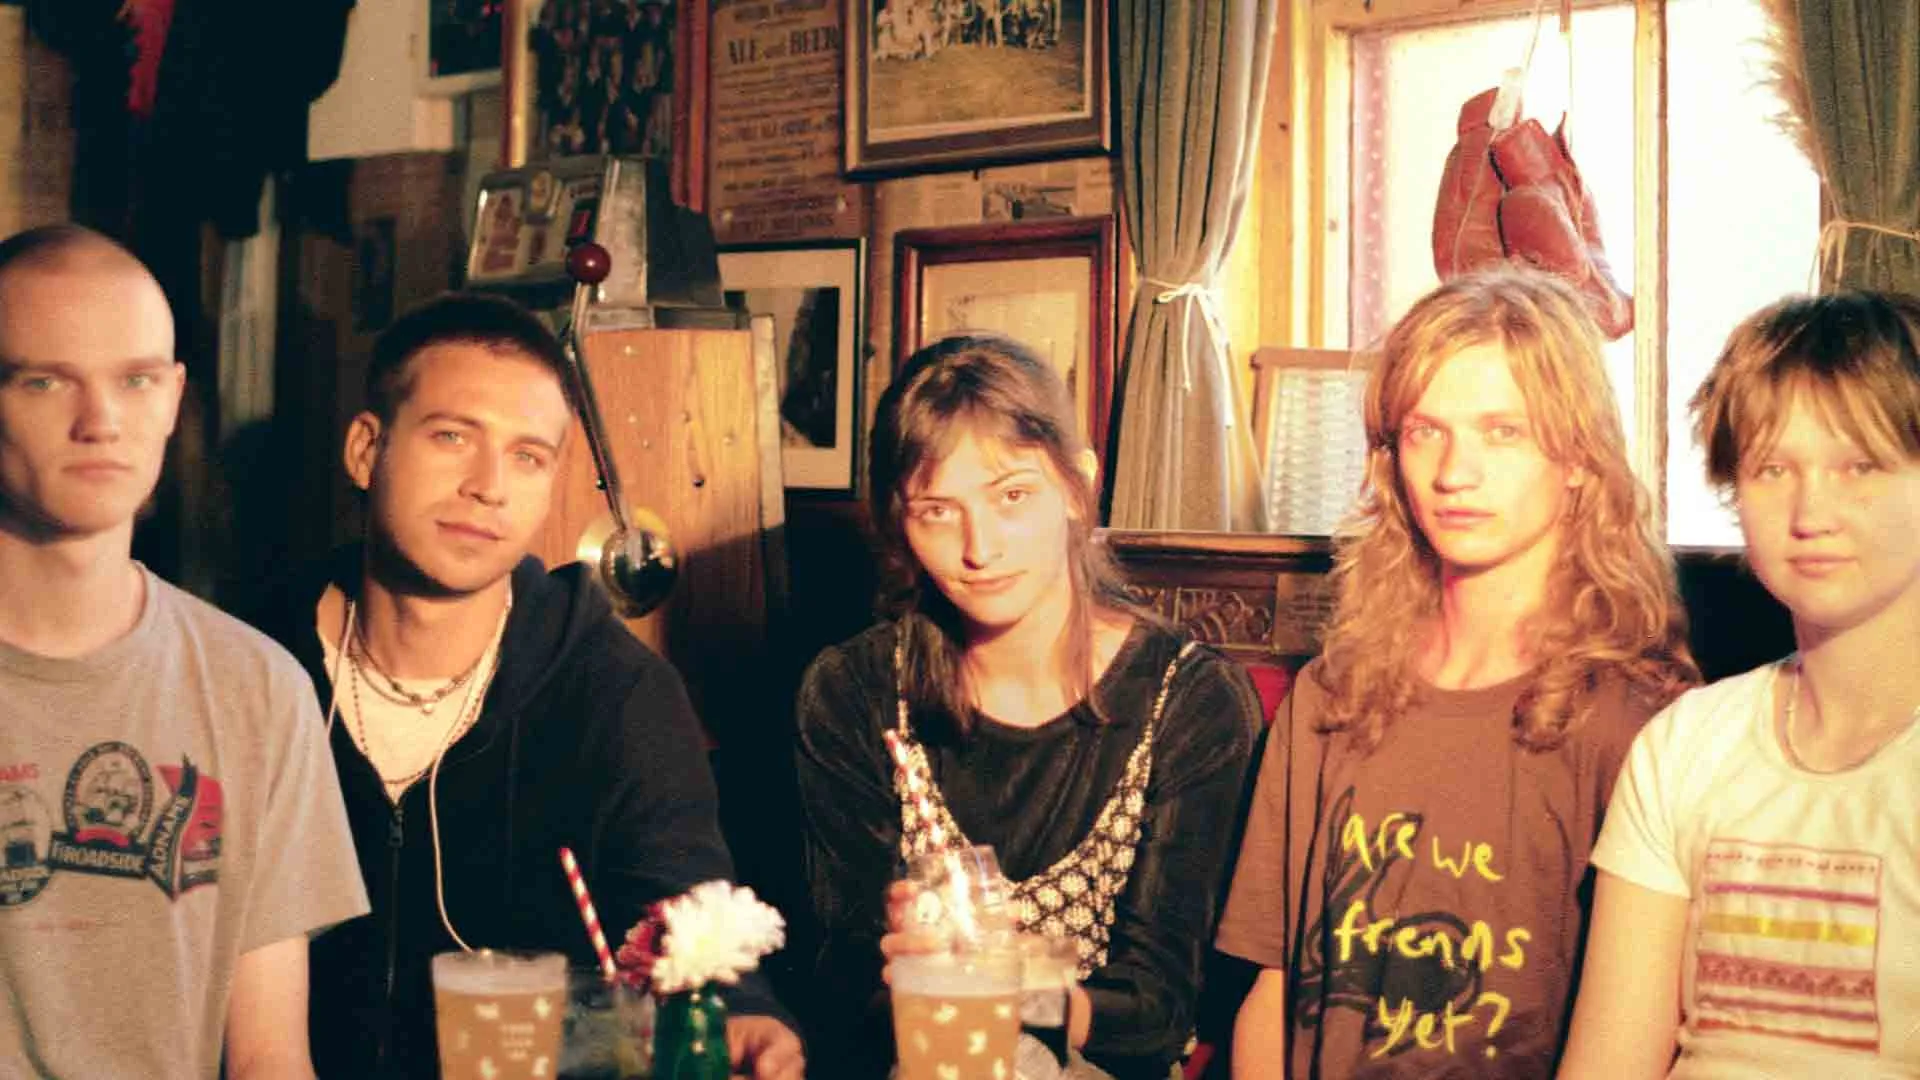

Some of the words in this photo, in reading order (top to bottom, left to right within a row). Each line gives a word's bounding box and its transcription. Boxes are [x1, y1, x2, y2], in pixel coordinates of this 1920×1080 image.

[728, 38, 757, 65] ALE
[789, 26, 838, 56] BEER
[1343, 812, 1416, 872] are
[1432, 835, 1504, 882] we
[1370, 991, 1512, 1059] yet?
